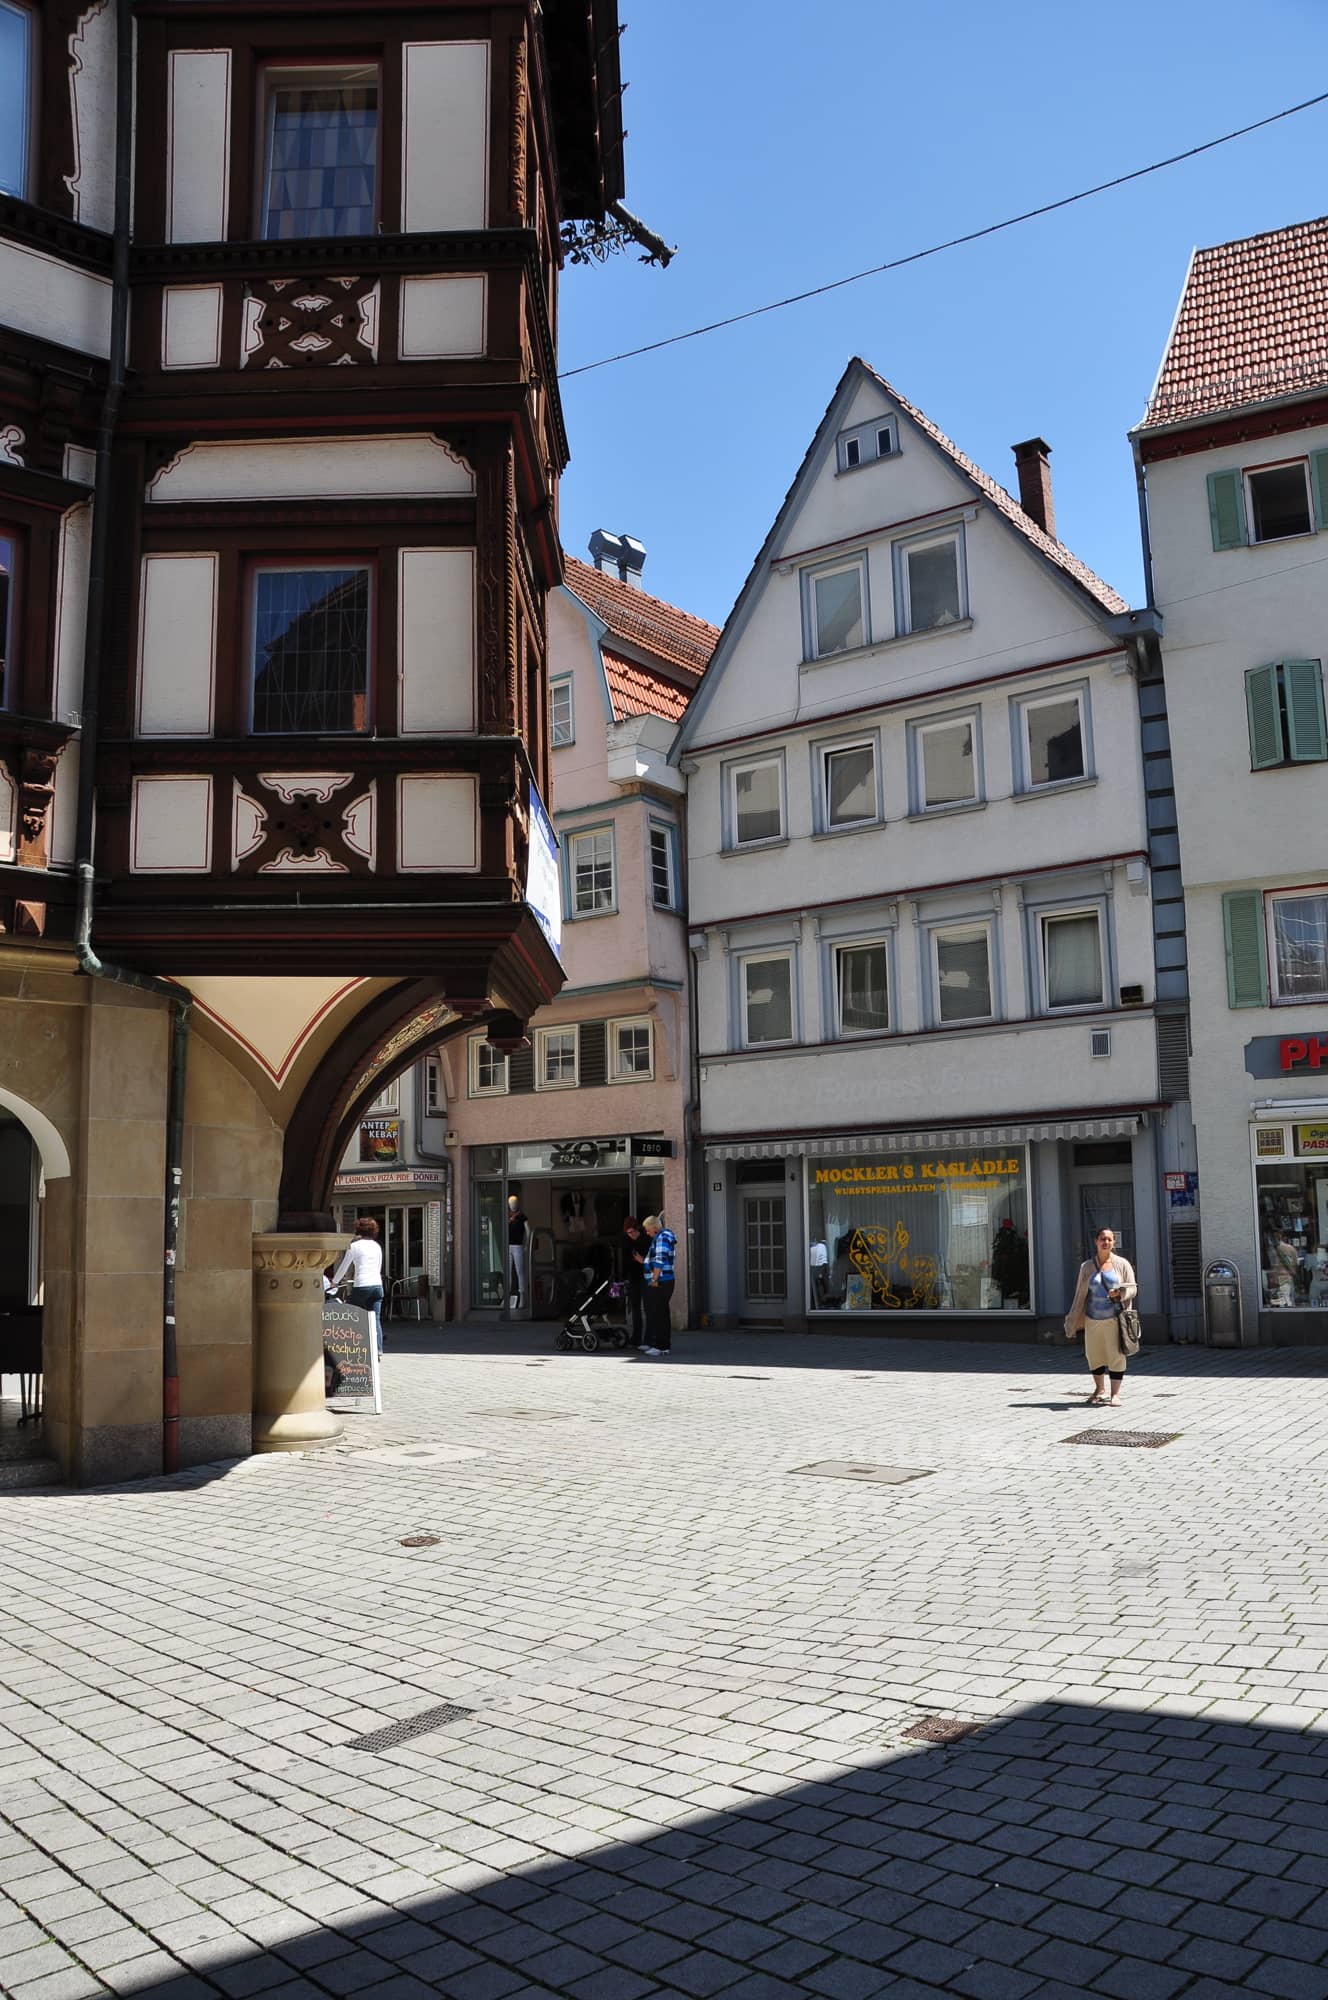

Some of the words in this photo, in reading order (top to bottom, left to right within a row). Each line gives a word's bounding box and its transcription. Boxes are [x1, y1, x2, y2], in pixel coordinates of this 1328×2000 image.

[361, 1121, 390, 1130] ANTEP
[369, 1130, 398, 1139] KEBAP
[641, 1142, 661, 1153] zero
[921, 1158, 1019, 1178] KÄSLÄDLE
[378, 1173, 394, 1181] PIZZA
[321, 1310, 359, 1321] tarbucks
